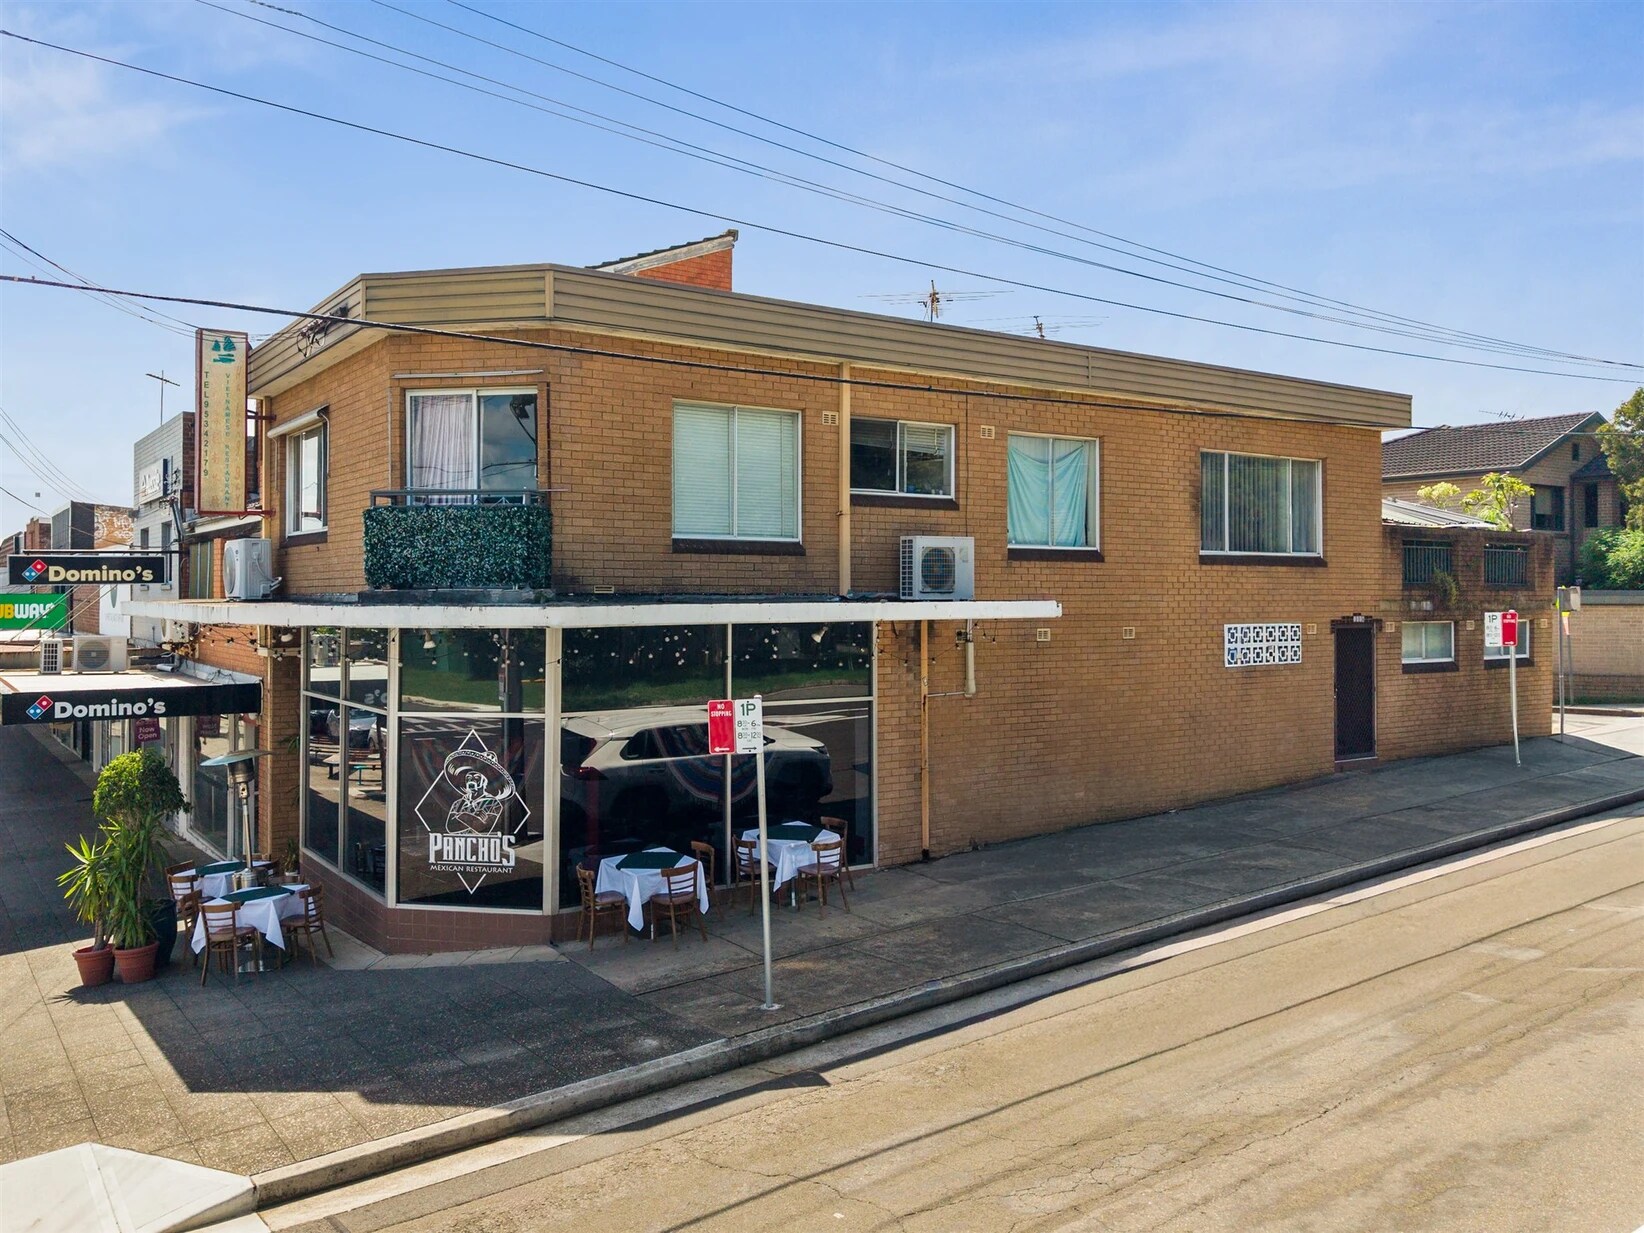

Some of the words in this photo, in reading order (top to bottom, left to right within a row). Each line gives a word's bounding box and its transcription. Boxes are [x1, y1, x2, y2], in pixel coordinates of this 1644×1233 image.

[48, 565, 154, 582] Domino's
[54, 698, 166, 719] Domino's
[740, 703, 756, 716] 1P
[137, 733, 157, 741] Open
[428, 831, 516, 866] PANCHO'S
